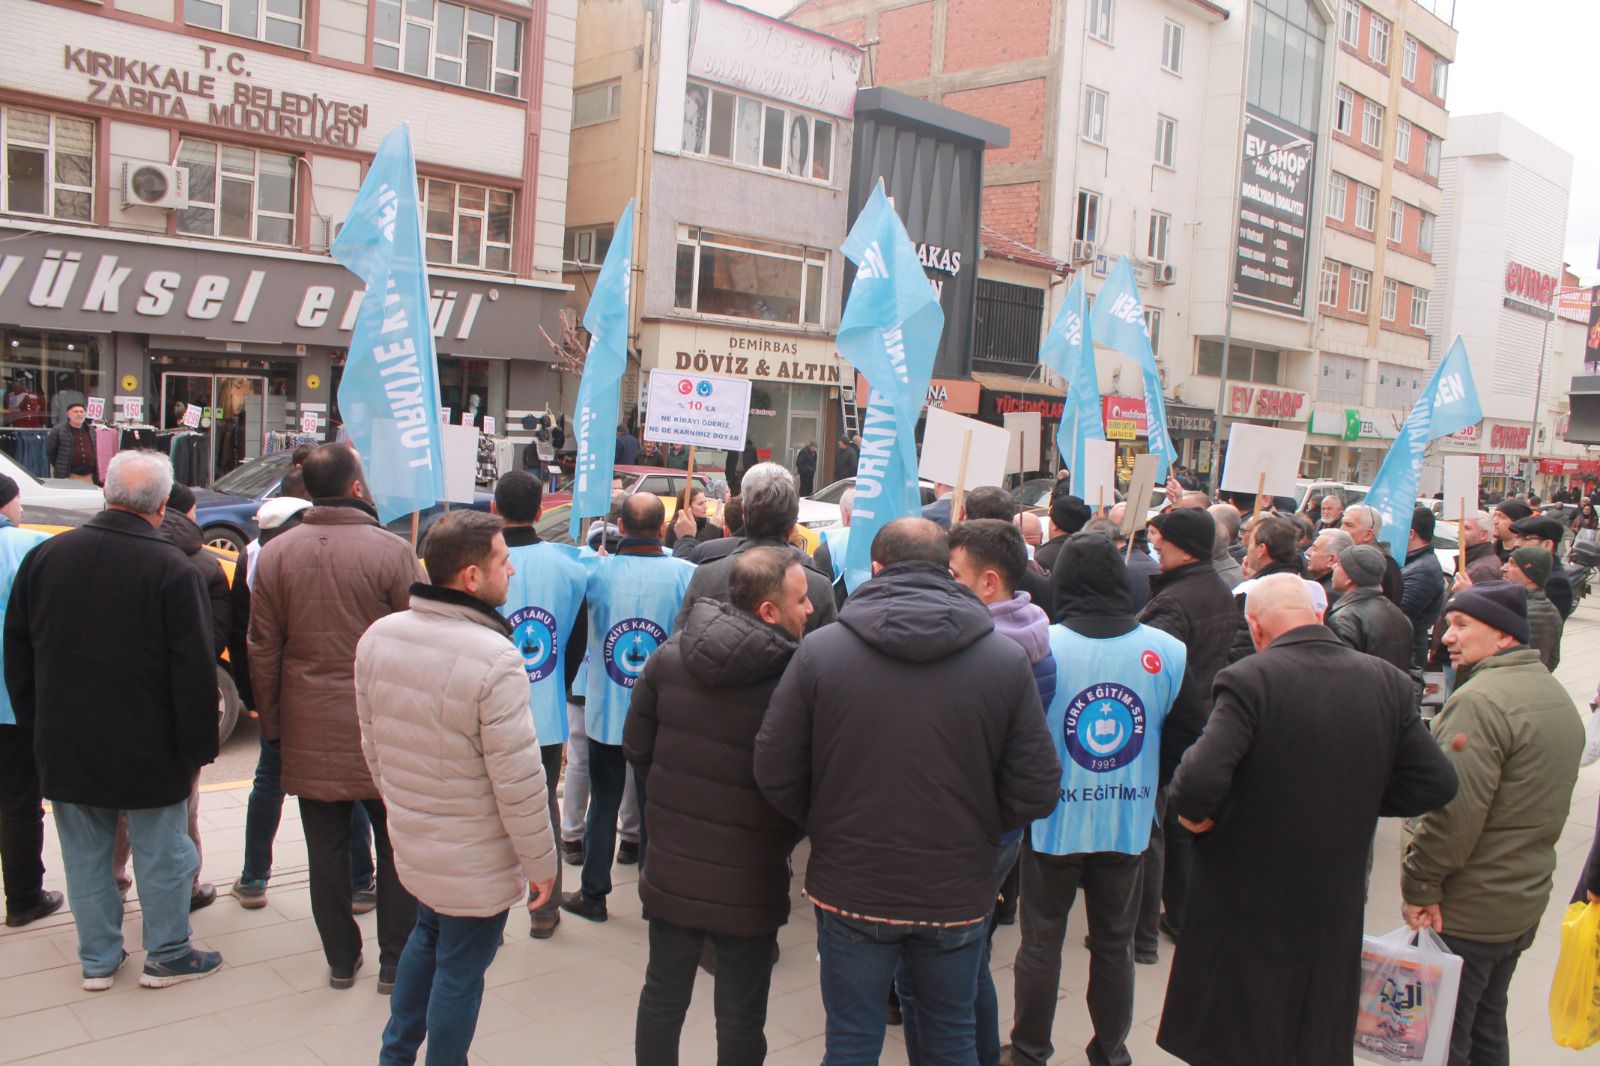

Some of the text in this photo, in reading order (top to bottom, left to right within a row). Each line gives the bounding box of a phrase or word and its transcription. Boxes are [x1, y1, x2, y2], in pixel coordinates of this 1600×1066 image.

[199, 44, 252, 77] T.C.
[64, 44, 369, 129] KIRIKKALE BELEDİYESİ
[88, 78, 190, 121] ZABITA
[1245, 133, 1267, 160] EV
[1268, 143, 1306, 177] SHOP
[911, 241, 961, 277] AKAŞ
[729, 337, 798, 355] DEMİRBAŞ
[675, 349, 841, 383] DÖVİZ & ALTIN
[89, 404, 103, 417] 99
[126, 403, 139, 417] 150
[687, 400, 703, 411] 10
[1231, 386, 1304, 418] EV SHOP
[304, 419, 316, 431] 99
[673, 415, 700, 425] KİRAYI
[1360, 420, 1373, 433] TEB
[712, 432, 739, 441] DOYAR
[523, 610, 552, 626] KAMU
[632, 620, 662, 638] KAMU
[1066, 683, 1144, 736] TÜRK EĞİTİM-SEN
[1091, 758, 1117, 770] 1992
